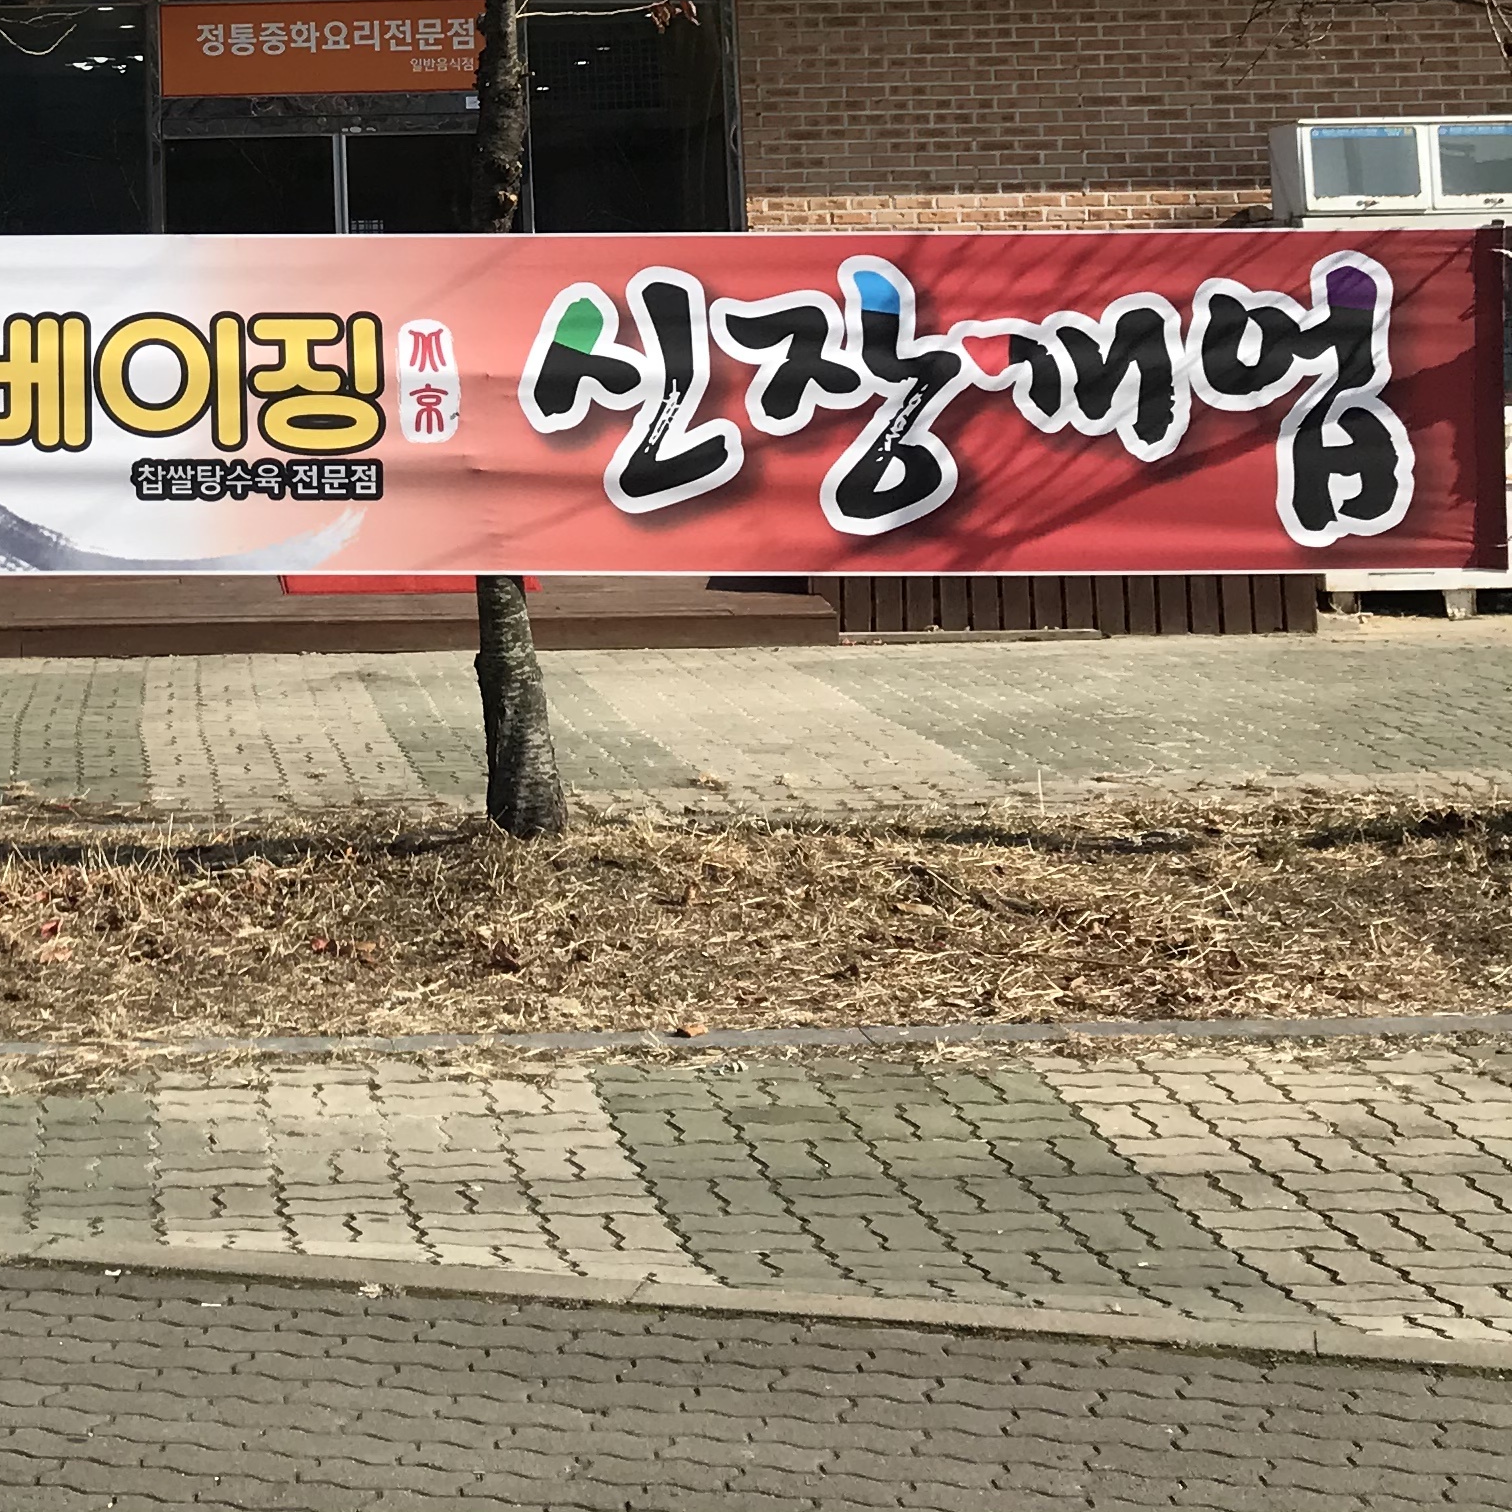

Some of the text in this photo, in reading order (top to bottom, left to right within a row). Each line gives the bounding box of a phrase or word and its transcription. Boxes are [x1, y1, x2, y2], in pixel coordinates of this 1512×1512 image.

[196, 17, 476, 57] 정통중화요리전문점
[409, 57, 475, 73] 일반음식점
[516, 248, 1417, 548] 신장개업
[135, 461, 379, 498] 찹쌀탕수육 전문점
